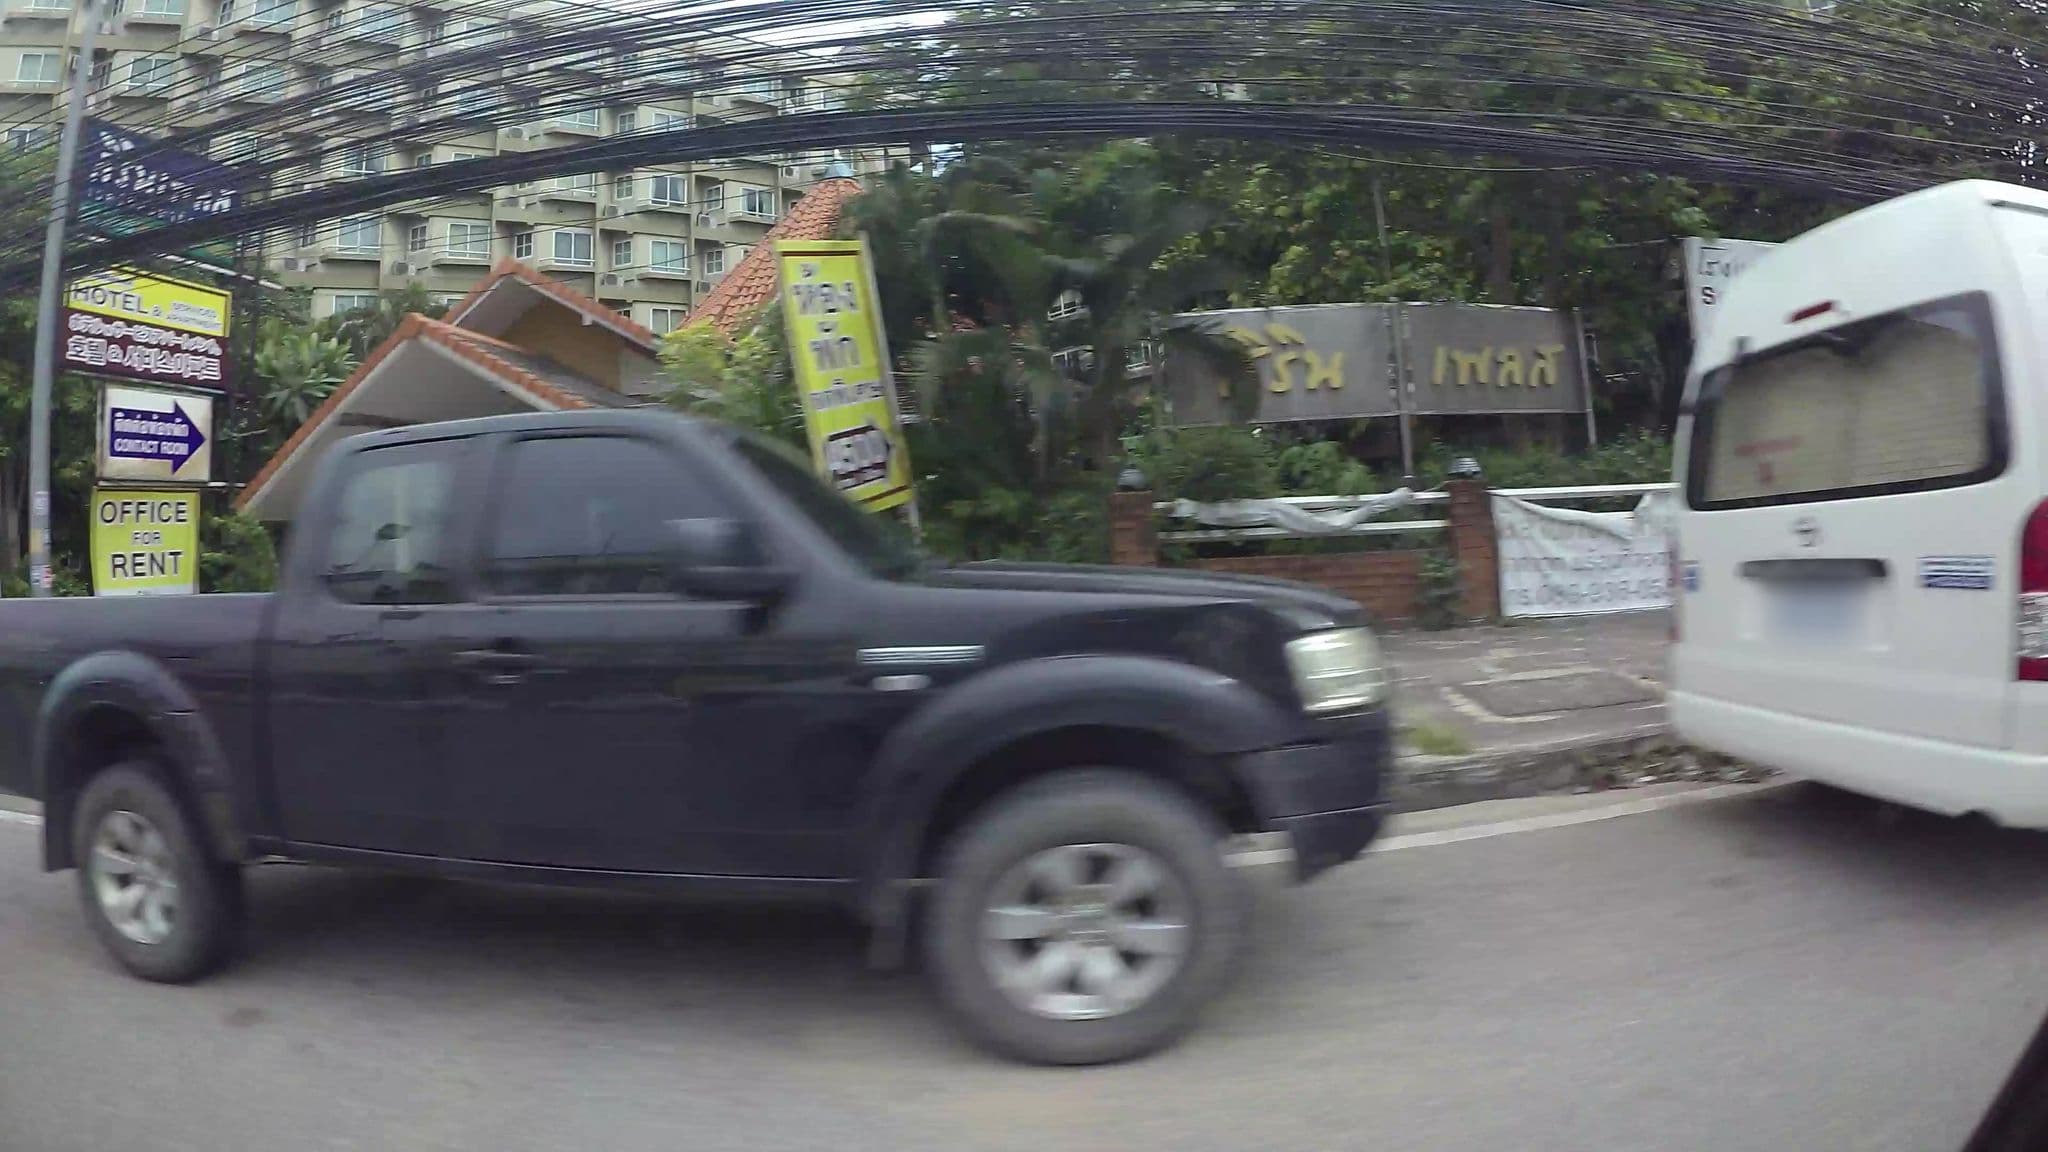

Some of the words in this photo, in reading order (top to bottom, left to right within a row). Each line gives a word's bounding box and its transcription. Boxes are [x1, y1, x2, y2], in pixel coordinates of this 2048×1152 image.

[71, 284, 148, 314] HOTEL
[789, 262, 861, 315] ห้อง
[114, 439, 159, 453] CONTACT
[160, 441, 189, 455] ROOM
[100, 501, 188, 524] OFFICE
[132, 531, 161, 546] FOR
[111, 550, 183, 578] RENT
